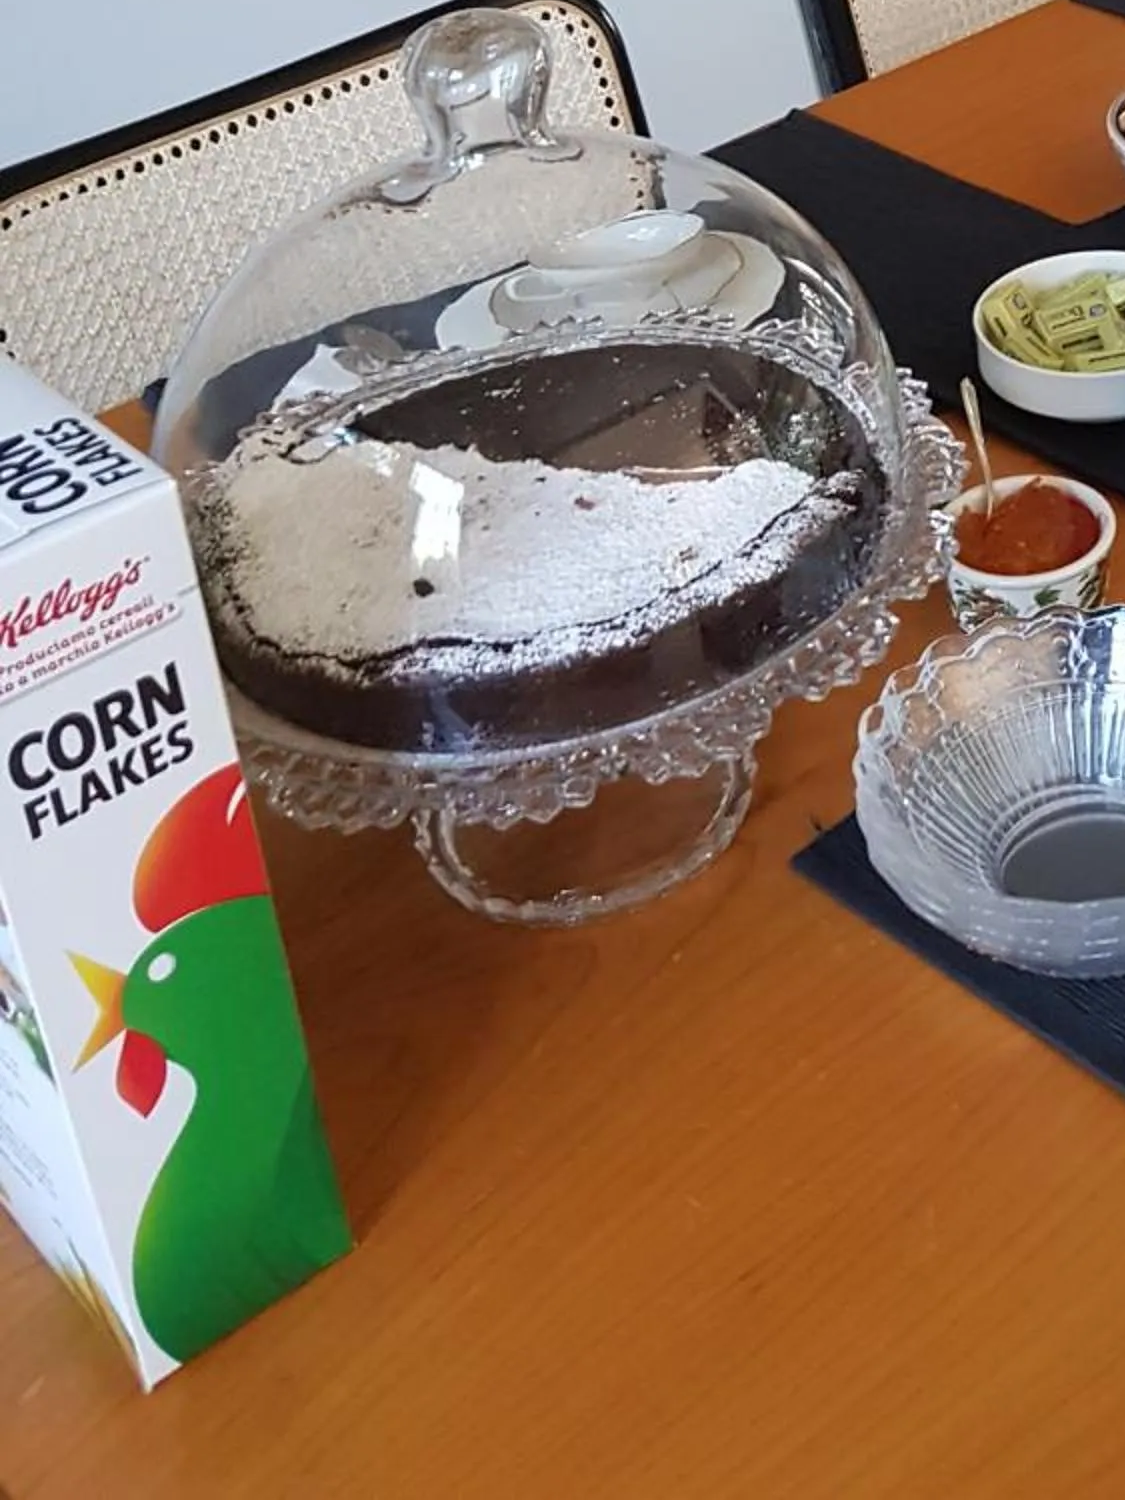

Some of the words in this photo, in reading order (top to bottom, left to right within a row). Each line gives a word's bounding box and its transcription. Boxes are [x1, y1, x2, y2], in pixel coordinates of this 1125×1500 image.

[33, 417, 144, 487] FLAKES
[0, 558, 143, 649] Kellogg's
[8, 661, 186, 791] CORN
[23, 720, 194, 841] FLAKES
